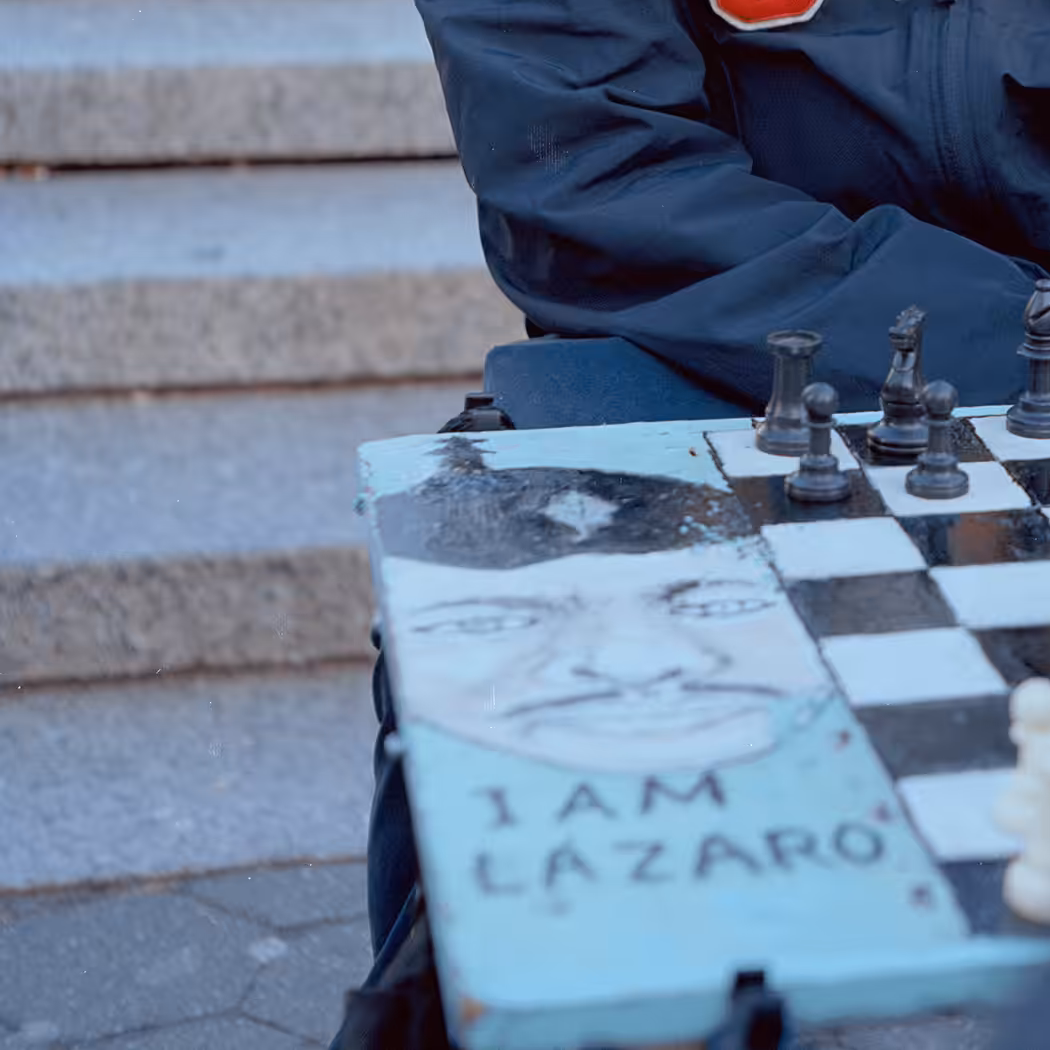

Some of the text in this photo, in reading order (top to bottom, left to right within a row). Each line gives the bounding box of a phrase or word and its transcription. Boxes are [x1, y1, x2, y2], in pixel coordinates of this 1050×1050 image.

[473, 772, 728, 828] I AM
[474, 824, 886, 896] LAZARO
